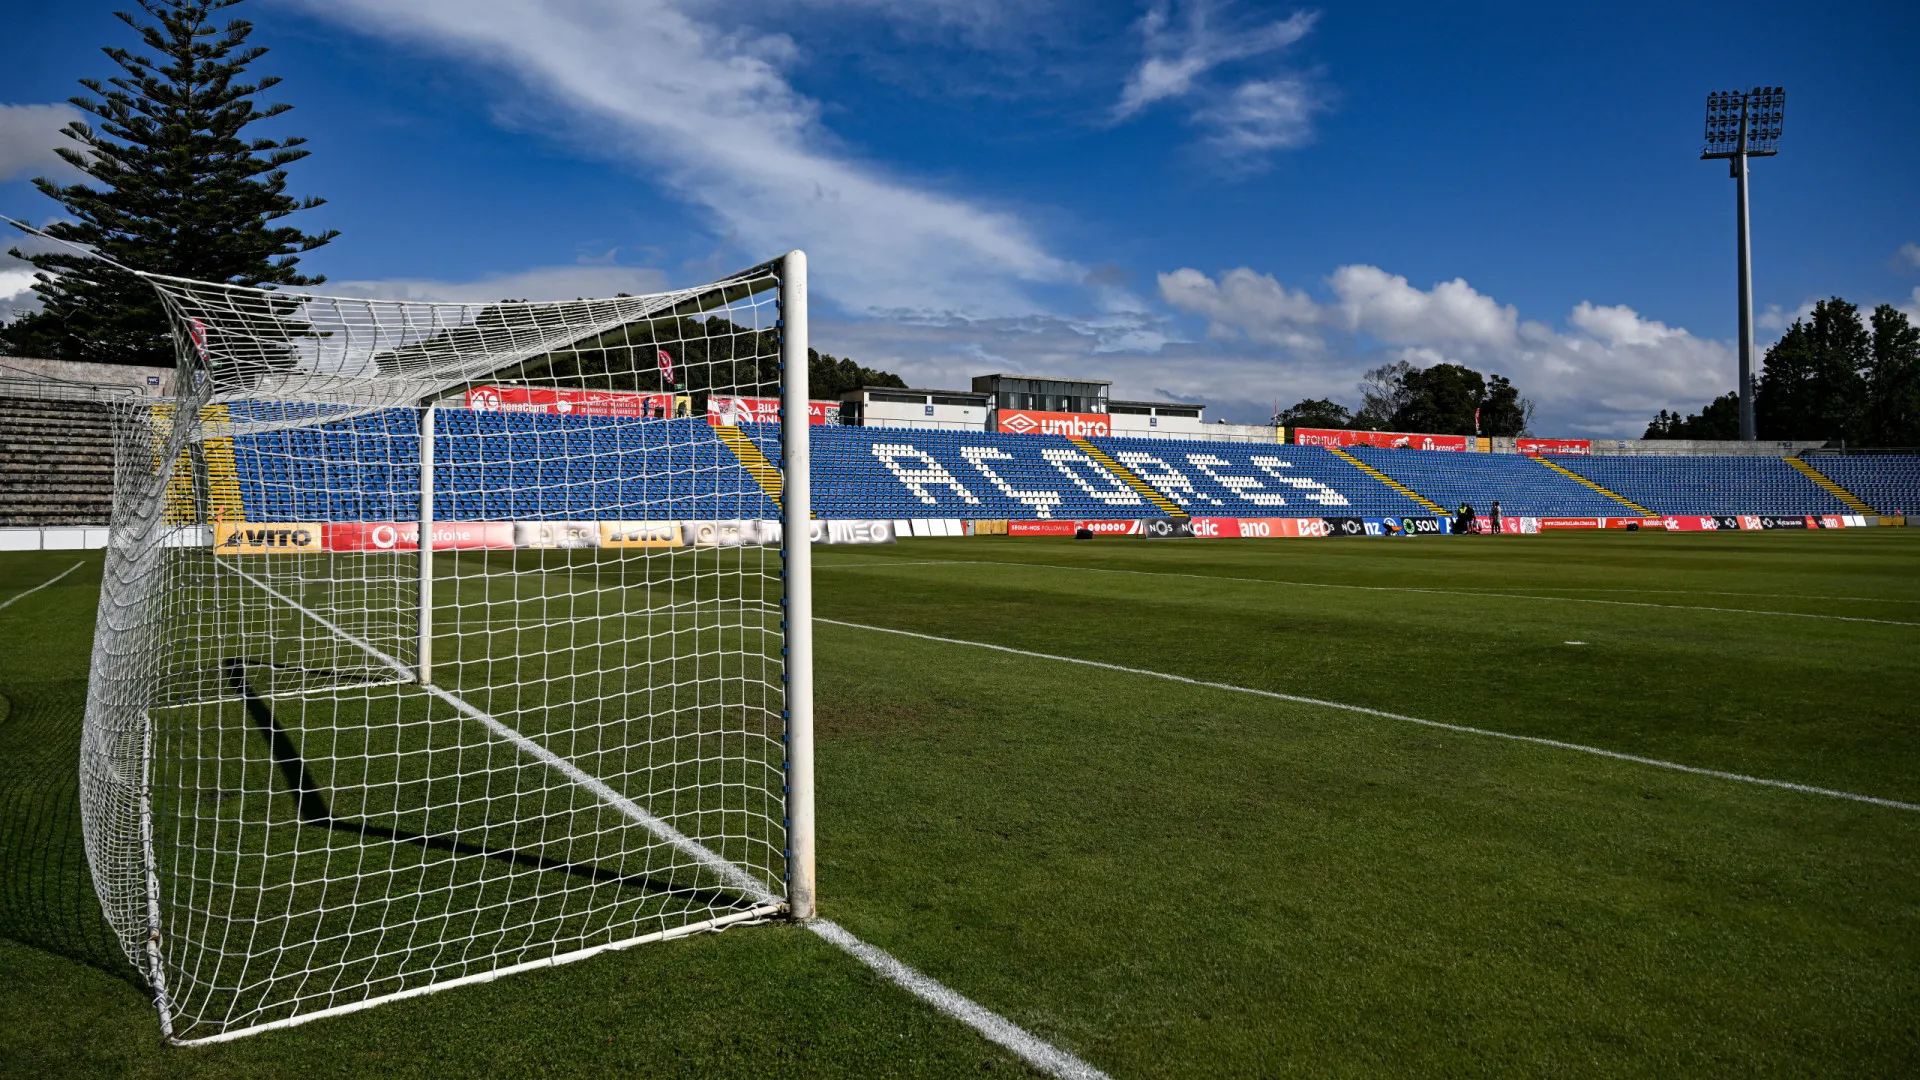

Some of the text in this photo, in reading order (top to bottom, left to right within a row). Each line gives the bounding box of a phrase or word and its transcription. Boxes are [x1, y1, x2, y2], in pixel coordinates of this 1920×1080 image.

[1041, 416, 1108, 436] umbro
[1306, 435, 1341, 446] PONTUAL
[872, 443, 1350, 518] AÇORES
[402, 529, 471, 541] voafone
[836, 523, 889, 541] MEO
[1149, 520, 1173, 536] NOS
[1194, 518, 1219, 536] clic
[1241, 522, 1270, 537] ano
[1297, 518, 1327, 536] Bet
[1341, 520, 1361, 534] NOS
